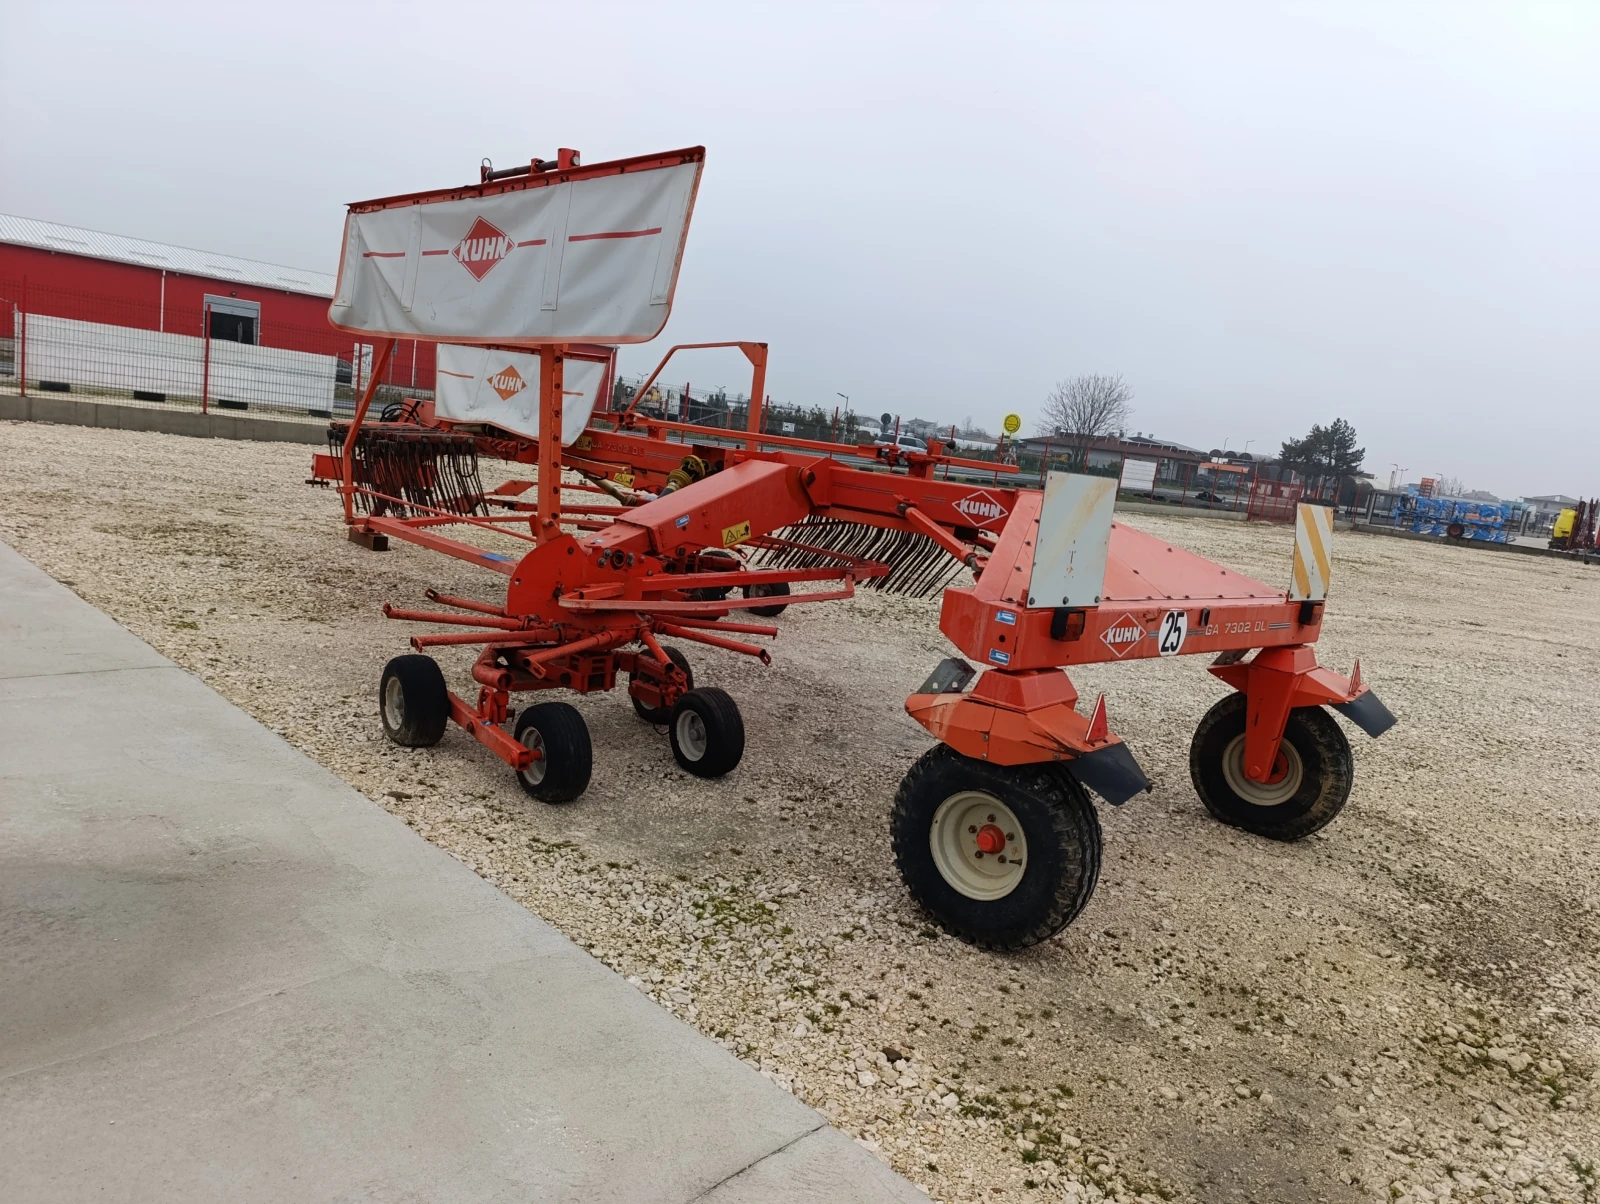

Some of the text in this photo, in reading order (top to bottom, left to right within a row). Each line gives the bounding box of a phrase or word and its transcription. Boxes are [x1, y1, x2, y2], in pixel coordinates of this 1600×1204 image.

[458, 235, 509, 262] KUHN
[491, 374, 523, 392] KUHN
[960, 498, 1001, 518] KUHN
[1106, 626, 1141, 644] KUHN
[1160, 611, 1184, 653] 25
[1205, 620, 1266, 636] GA 7302 DL
